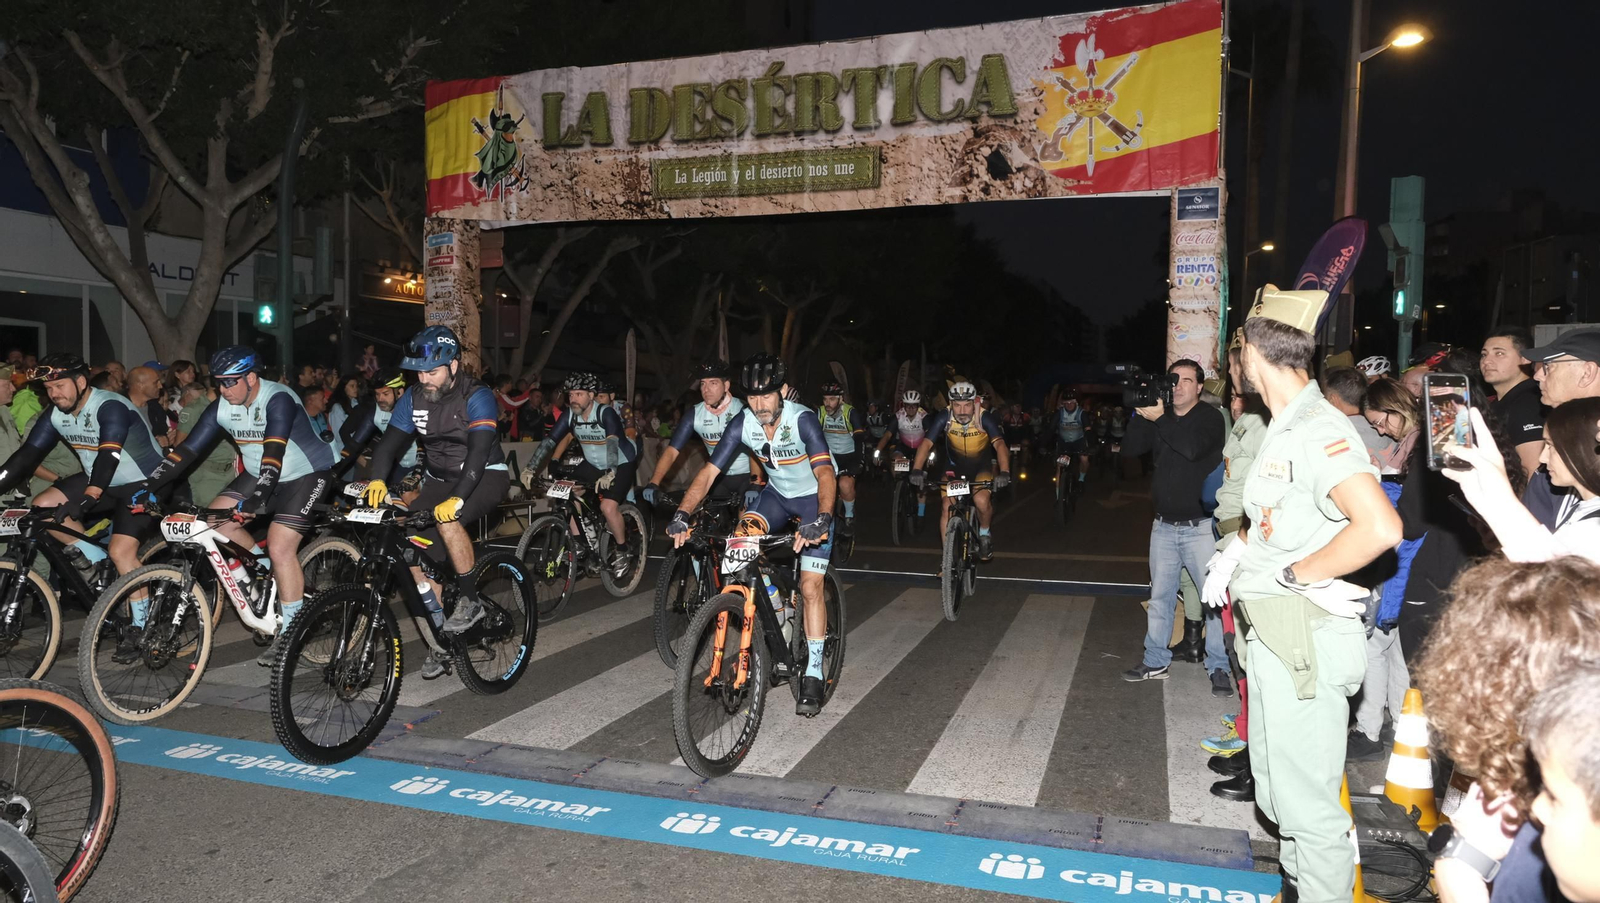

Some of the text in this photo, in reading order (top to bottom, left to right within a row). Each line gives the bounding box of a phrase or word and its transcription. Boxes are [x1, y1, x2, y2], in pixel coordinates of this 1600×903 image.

[542, 54, 1019, 148] LA DESÉRTICA
[674, 163, 855, 187] La Legión y el desierto nos une
[1176, 264, 1216, 274] RENTA
[166, 522, 191, 535] 7648
[728, 548, 756, 563] 8198
[210, 550, 247, 610] ORBEA
[393, 637, 401, 679] MAXXIS
[215, 753, 356, 779] cajamar
[449, 787, 612, 817] cajamar
[513, 806, 592, 823] CAJA RURAL
[729, 825, 922, 860] cajamar
[66, 822, 108, 893] SCORPION
[813, 848, 908, 867] CAJA RURAL
